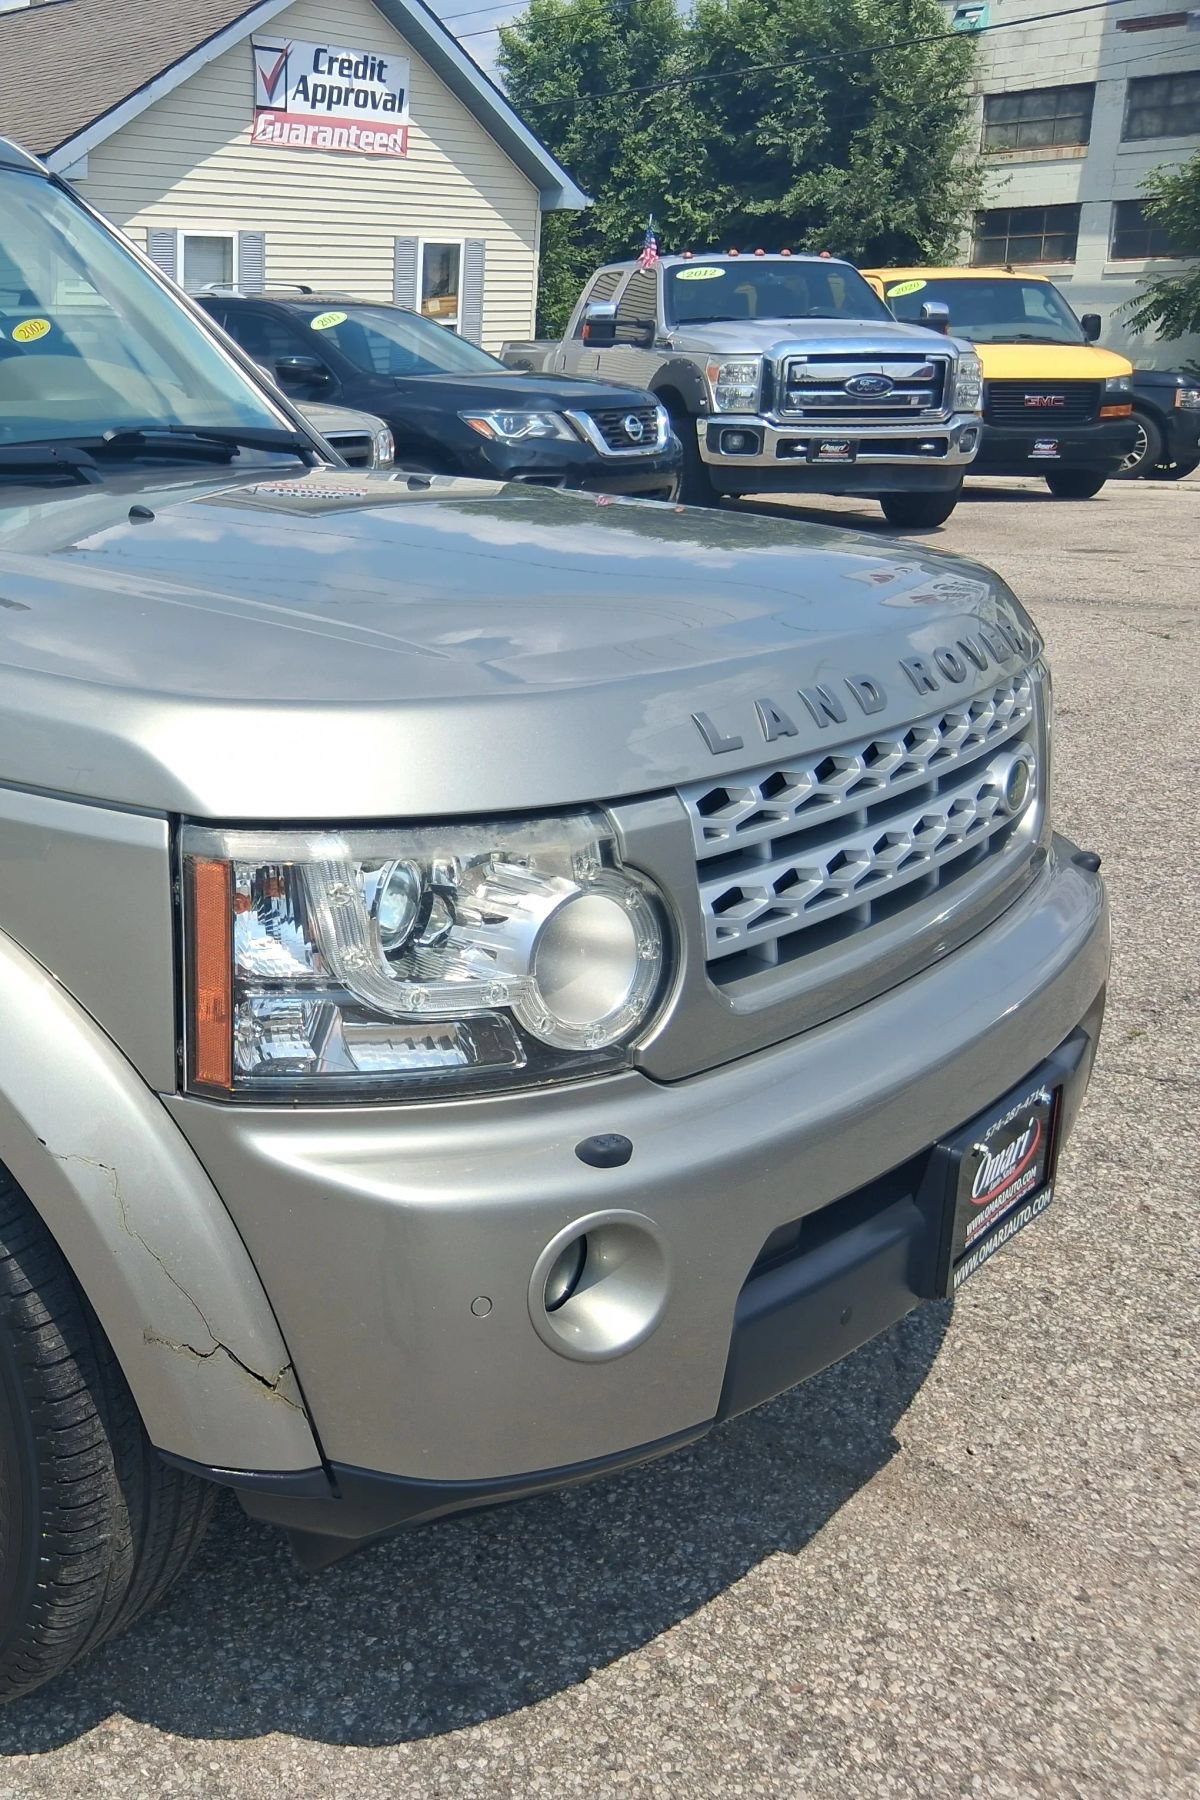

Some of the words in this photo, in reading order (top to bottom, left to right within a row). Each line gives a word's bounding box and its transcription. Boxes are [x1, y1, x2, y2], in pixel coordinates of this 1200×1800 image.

[313, 48, 388, 83] Credit
[292, 75, 405, 113] Approval
[254, 113, 404, 153] Guaranteed
[686, 269, 716, 278] 2012
[18, 321, 44, 339] 2002
[856, 379, 884, 391] Ford
[1025, 395, 1065, 407] GMC
[690, 673, 888, 755] LAND
[899, 623, 1026, 696] ROVER
[972, 1116, 1034, 1199] Omari
[953, 1187, 1052, 1290] WWW.OMARIAUTO.COM
